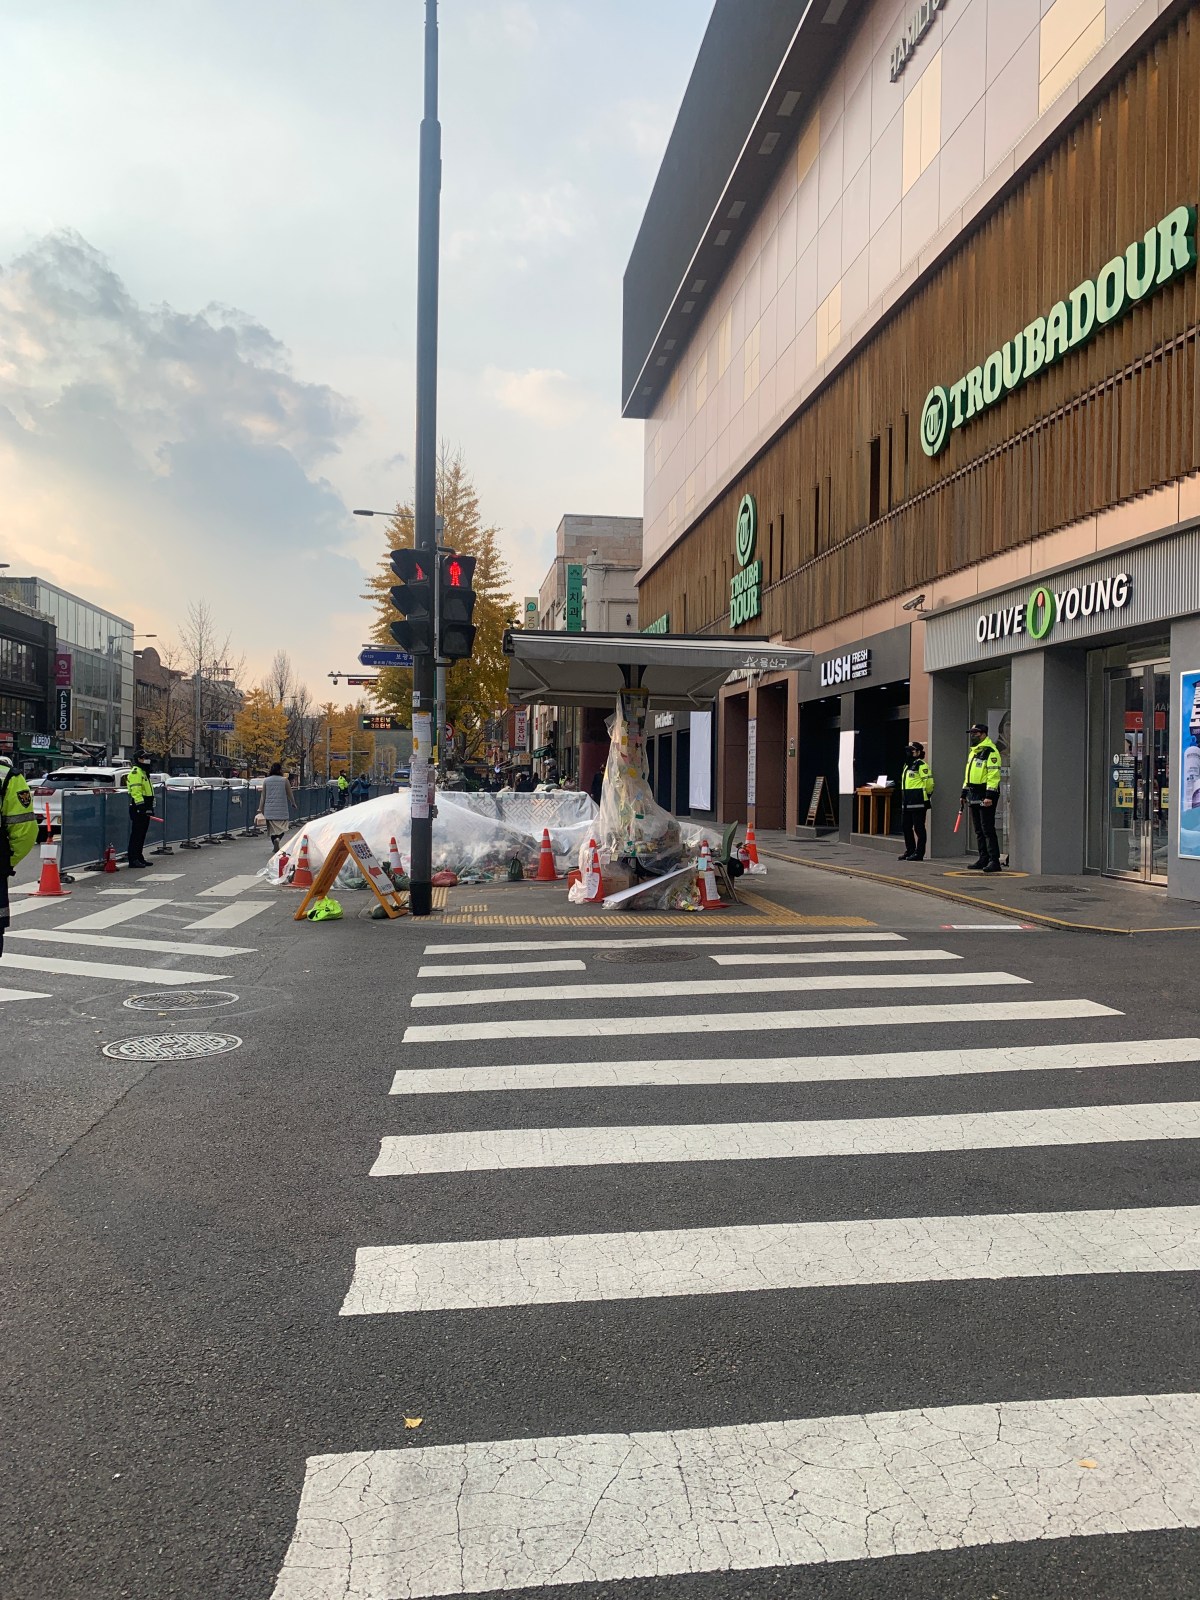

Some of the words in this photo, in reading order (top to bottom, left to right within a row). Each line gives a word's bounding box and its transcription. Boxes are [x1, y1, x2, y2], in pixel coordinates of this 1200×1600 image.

[950, 205, 1196, 429] TROUBADOUR
[730, 560, 762, 600] TROUBA
[568, 591, 580, 618] 치과
[729, 584, 762, 629] DOUR
[976, 604, 1026, 643] OLIVE
[1054, 573, 1131, 623] YOUNG
[760, 657, 788, 668] 용산구
[821, 654, 851, 687] LUSH
[851, 649, 868, 664] FRESH
[518, 717, 526, 742] 부동산
